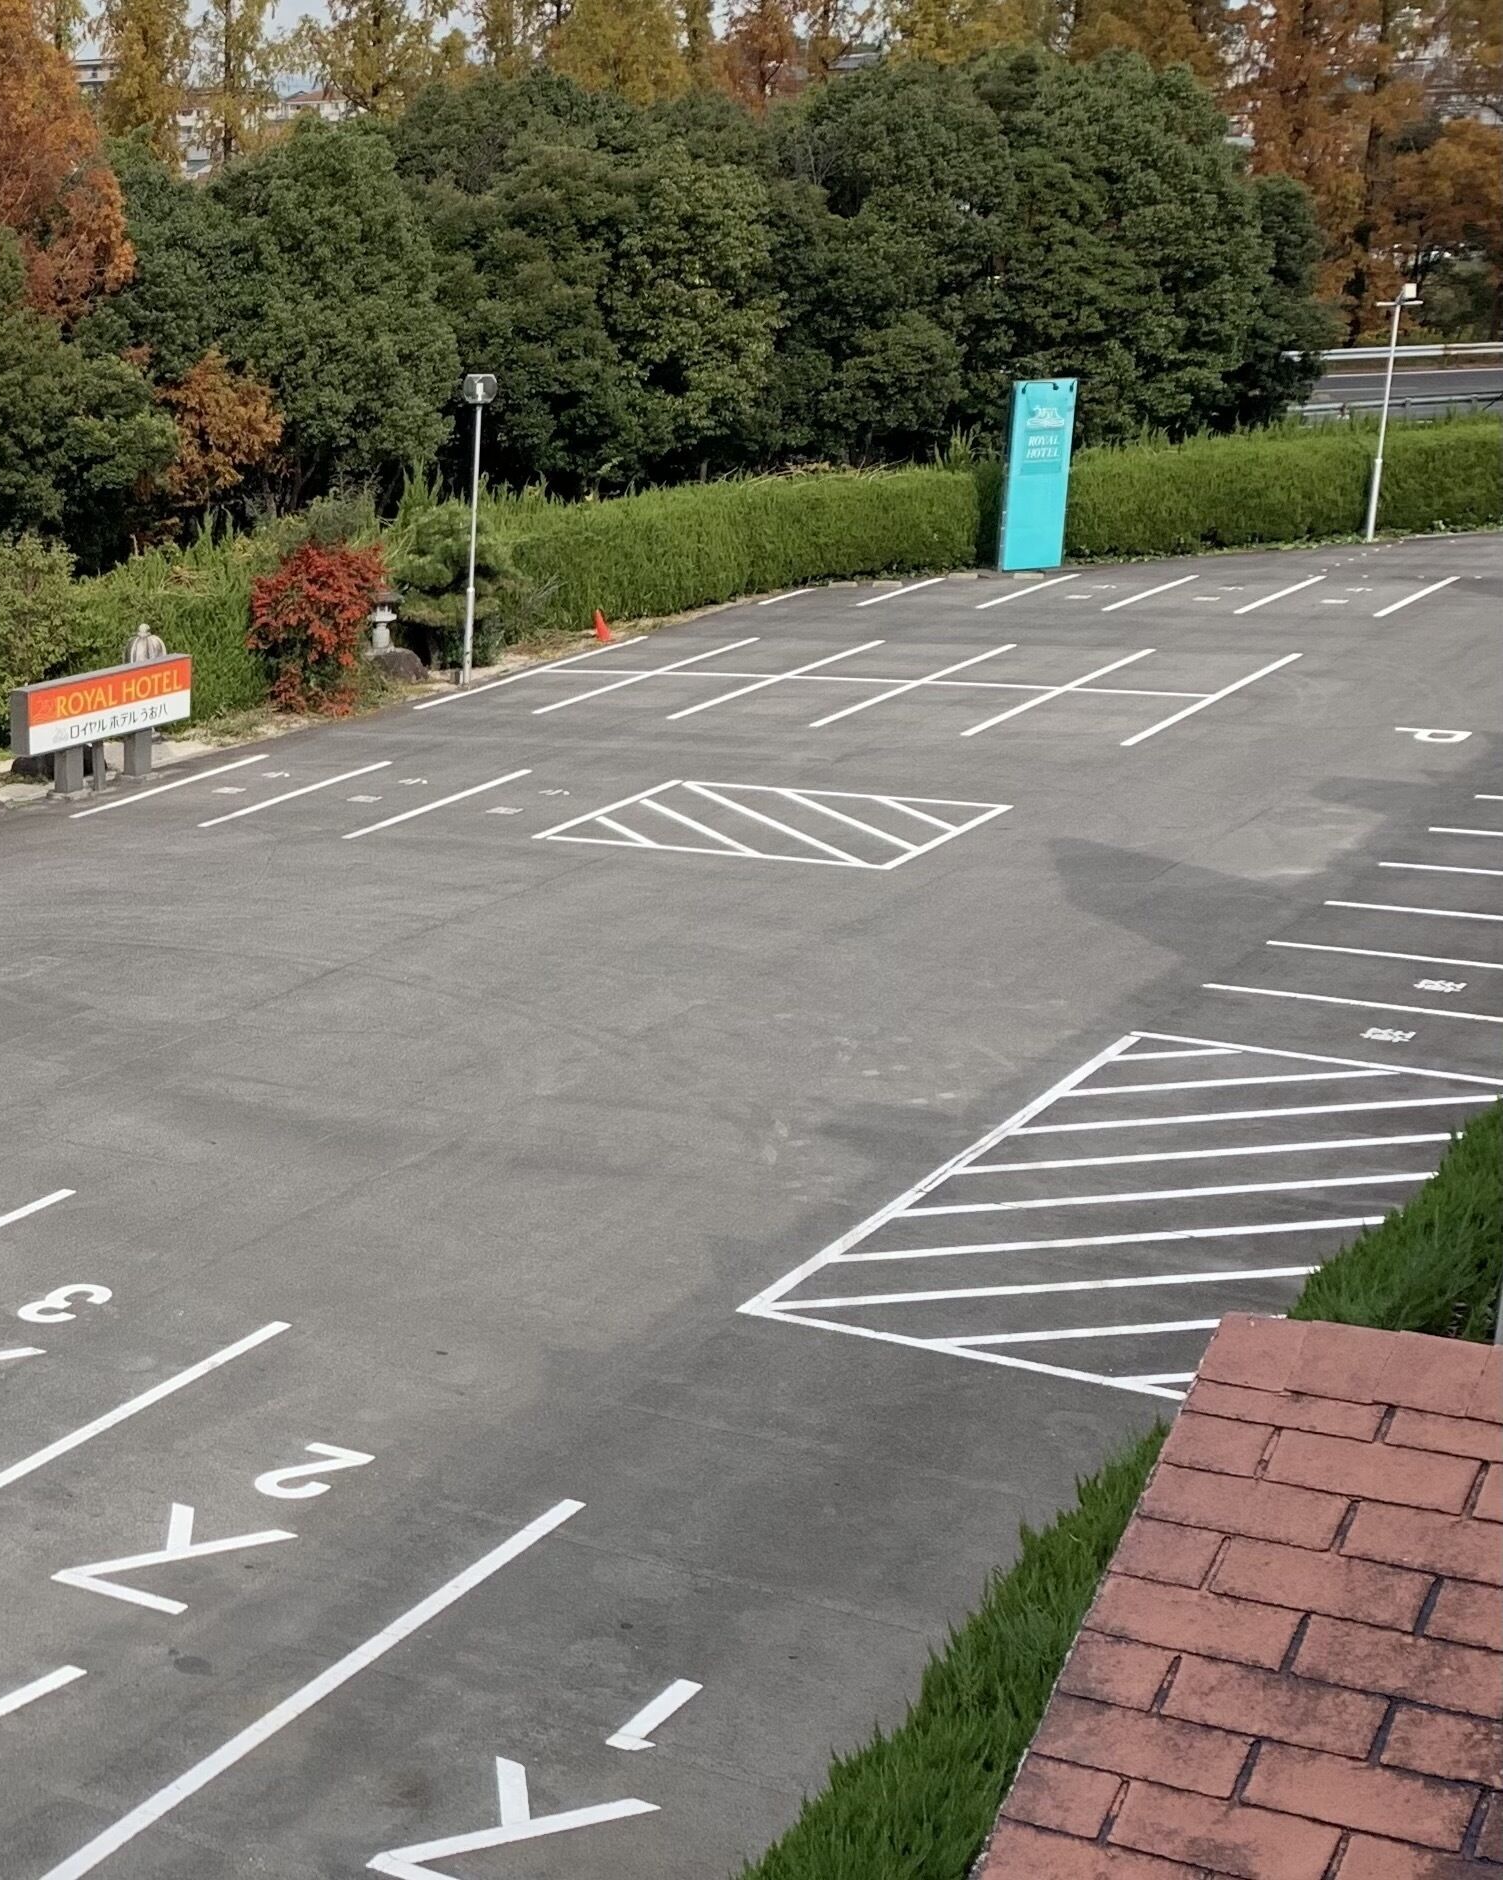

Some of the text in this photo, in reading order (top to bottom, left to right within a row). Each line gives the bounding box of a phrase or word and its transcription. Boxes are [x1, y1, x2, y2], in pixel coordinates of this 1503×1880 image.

[1028, 435, 1061, 447] ROYAL
[1026, 447, 1061, 459] HOTEL
[57, 670, 182, 717] ROYAL HOTEL
[70, 719, 106, 739] ロイヤル
[110, 711, 137, 729] ホテル
